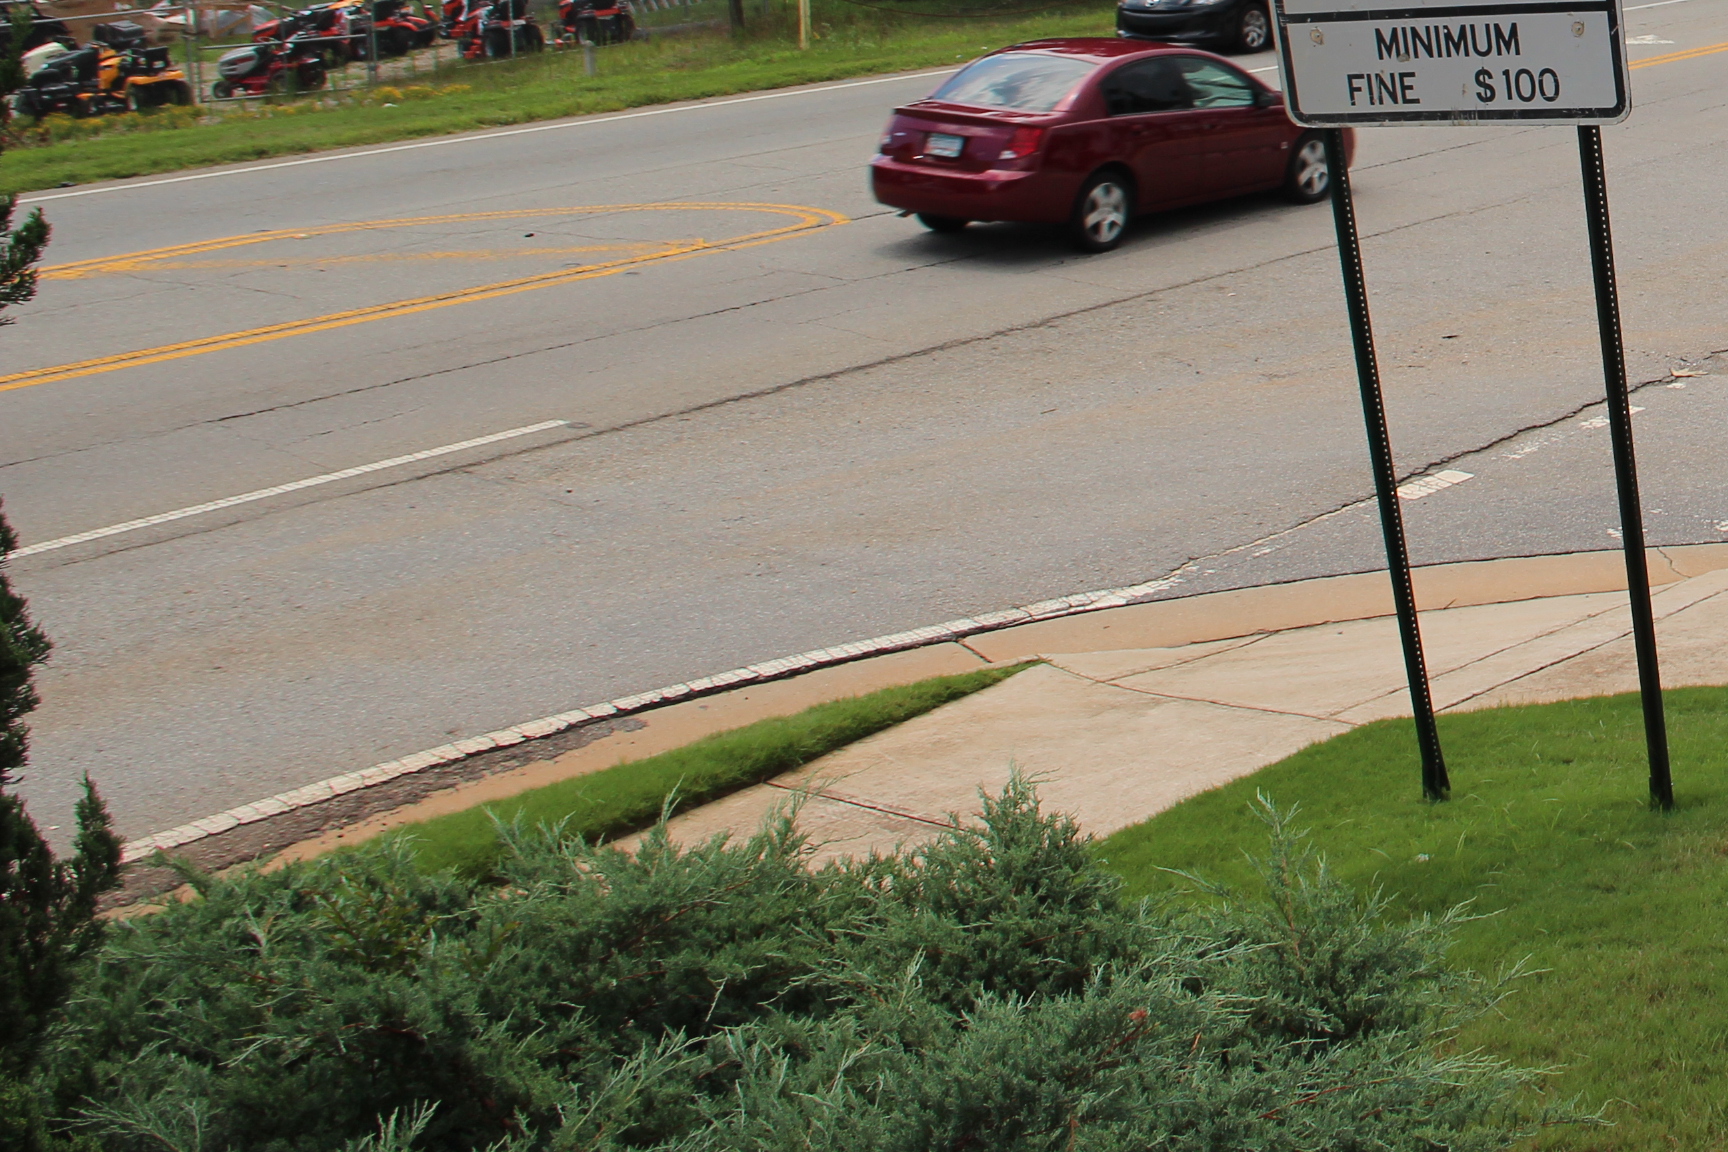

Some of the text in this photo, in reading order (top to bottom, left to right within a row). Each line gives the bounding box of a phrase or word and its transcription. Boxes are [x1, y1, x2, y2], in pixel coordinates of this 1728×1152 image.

[1374, 22, 1522, 61] MINIMUM
[1347, 66, 1561, 107] FINE $100
